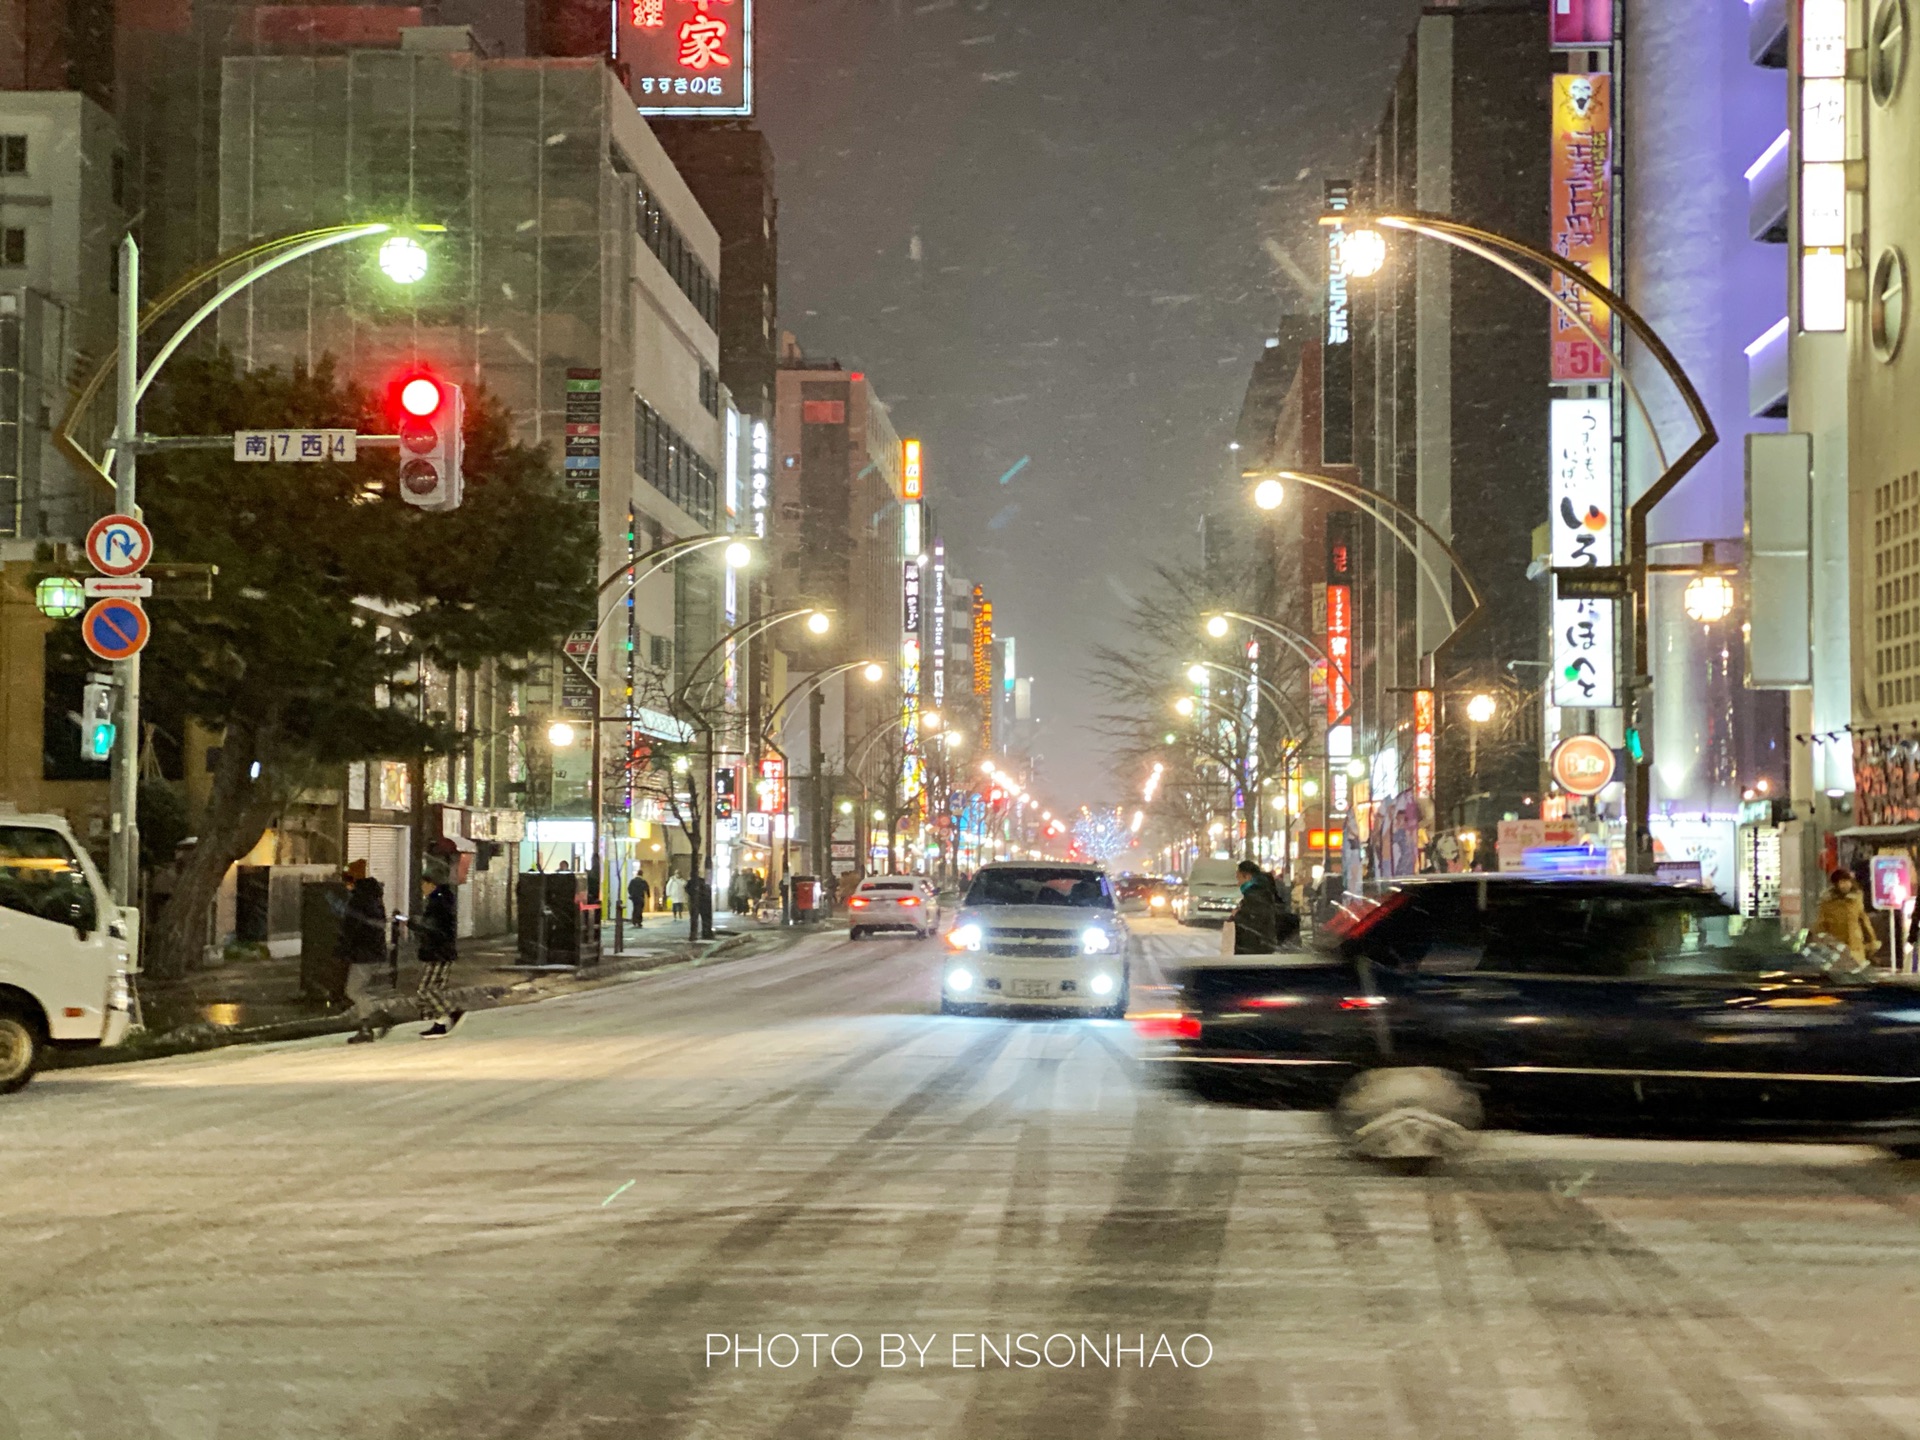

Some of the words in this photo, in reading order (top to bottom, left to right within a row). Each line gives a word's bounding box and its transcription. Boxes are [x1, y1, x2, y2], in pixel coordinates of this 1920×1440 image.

[641, 76, 722, 95] すすきの店
[245, 434, 346, 456] 南7西4
